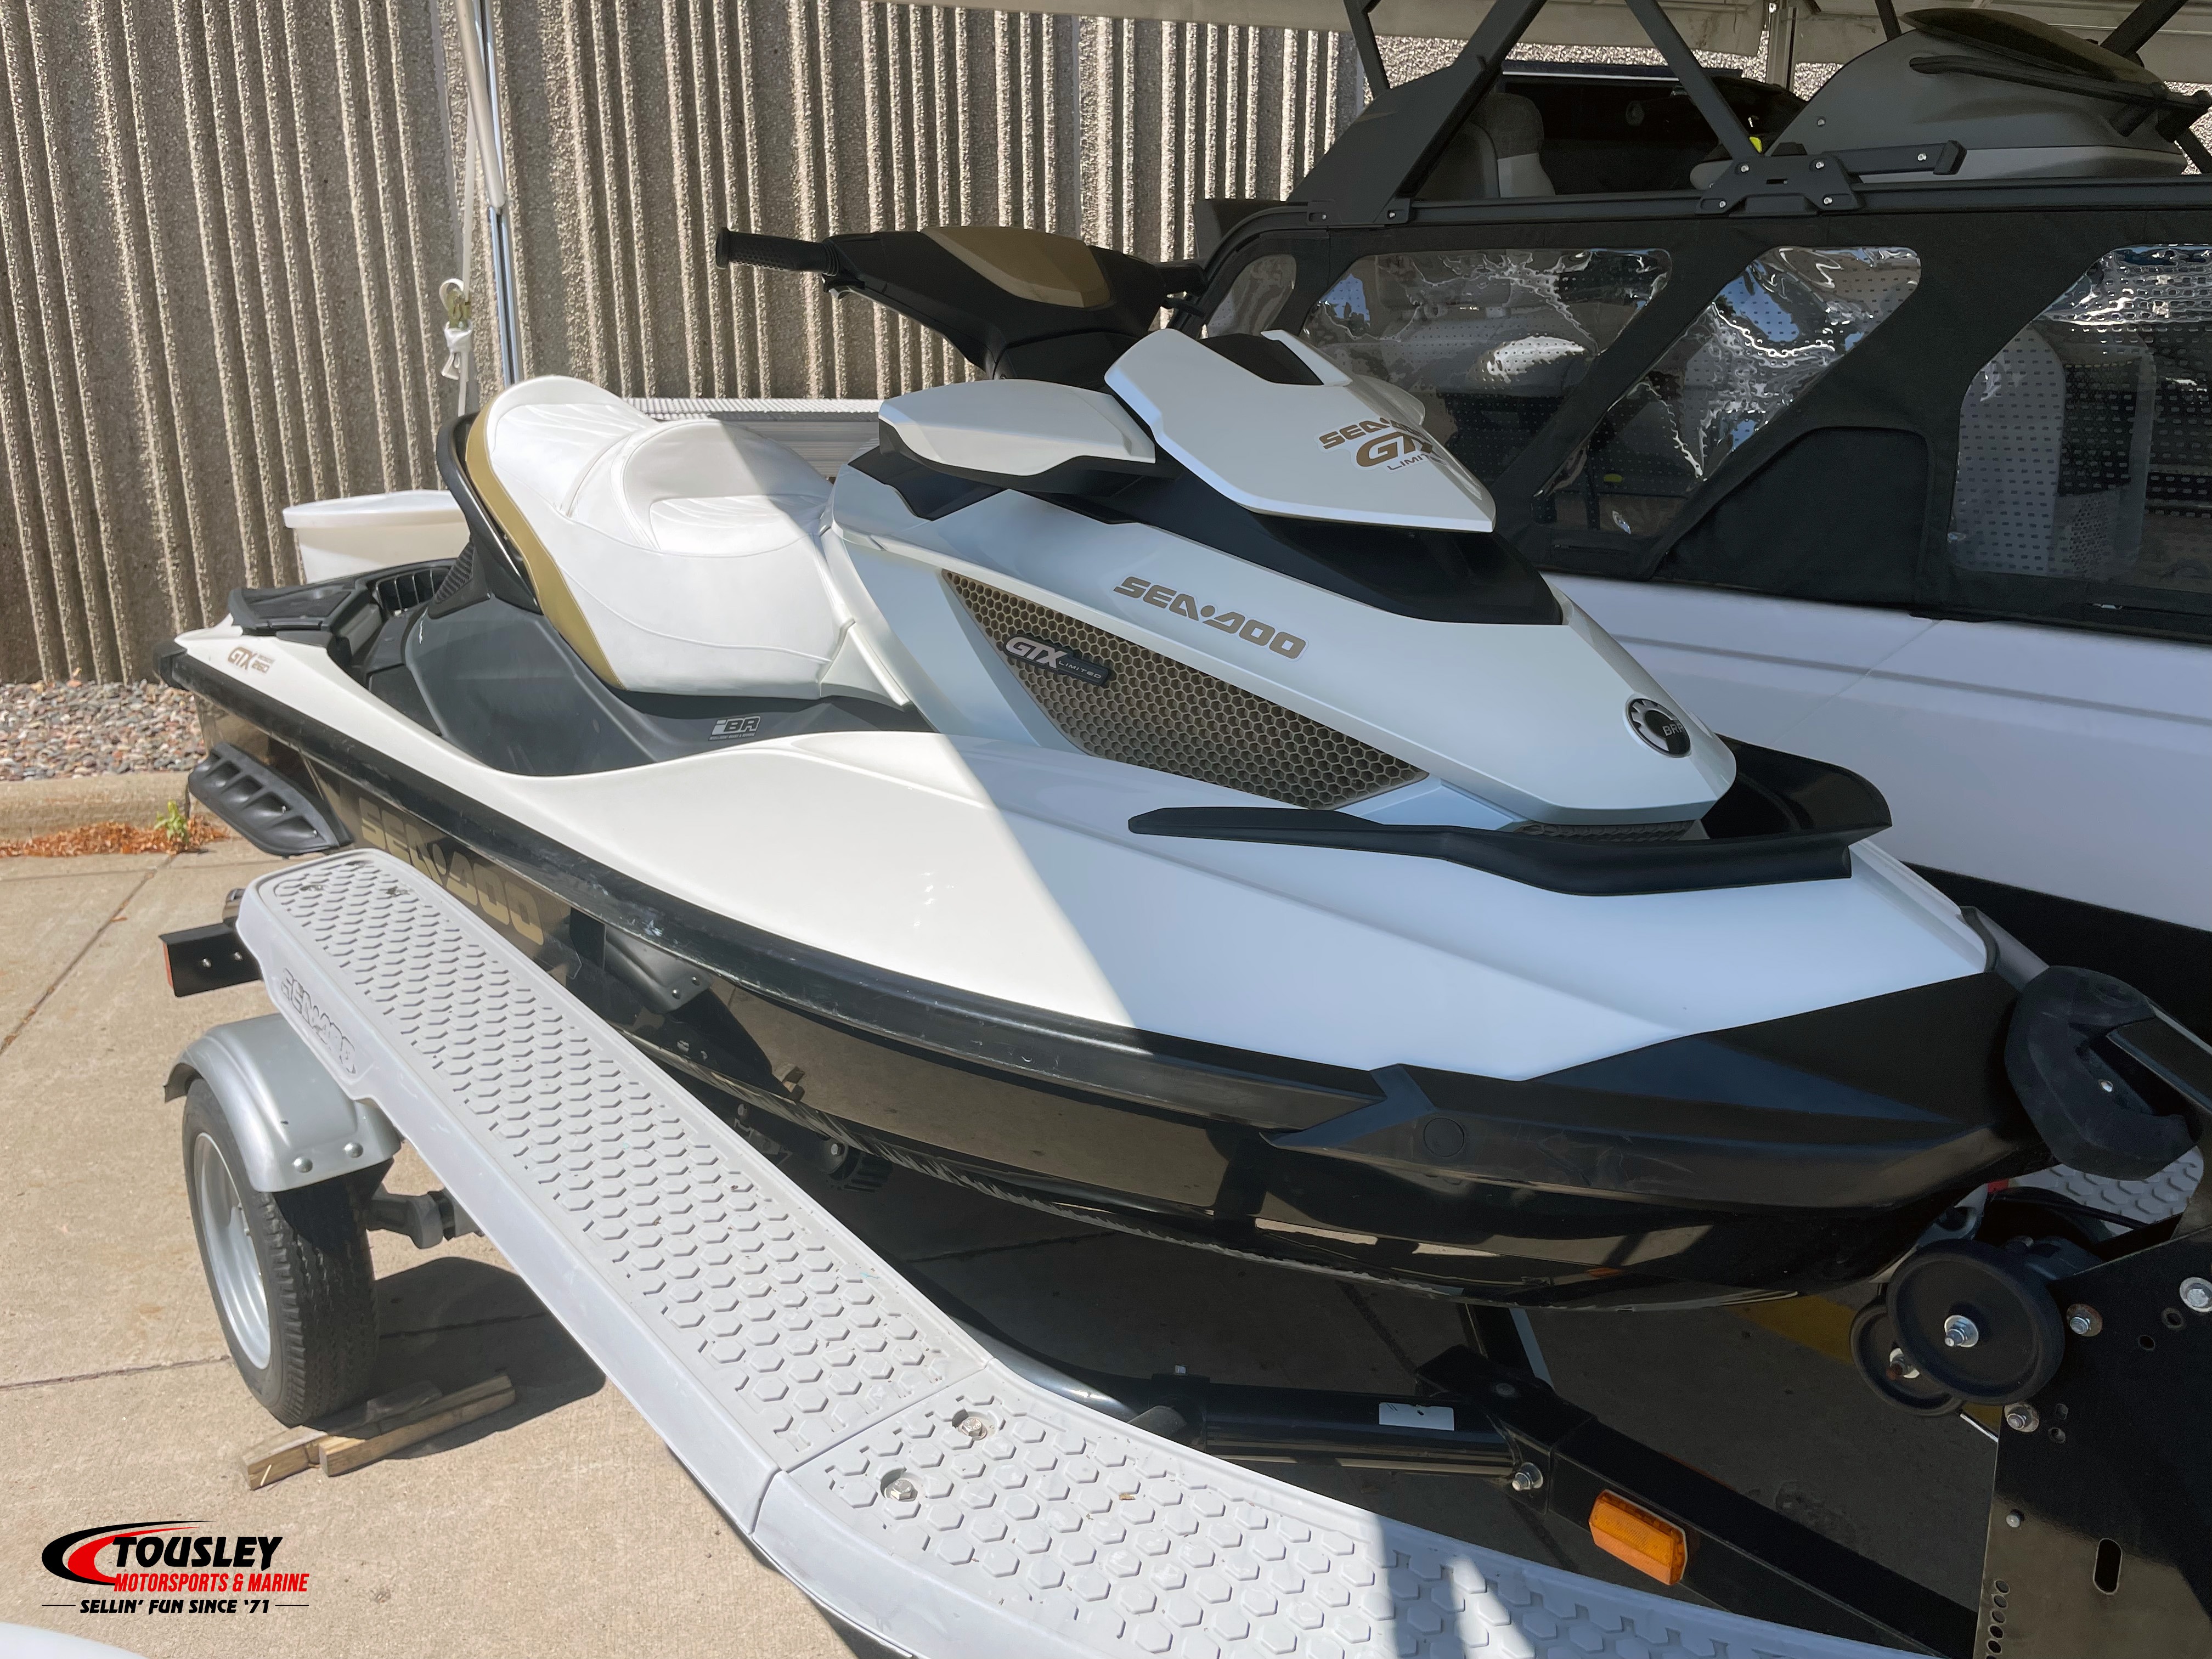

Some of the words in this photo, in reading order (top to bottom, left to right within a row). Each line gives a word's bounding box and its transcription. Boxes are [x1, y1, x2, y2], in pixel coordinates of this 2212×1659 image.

[1387, 454, 1447, 470] LIMIT
[228, 647, 258, 670] GTX
[1006, 637, 1068, 669] GTX
[1058, 660, 1102, 679] LIMITED
[1662, 723, 1683, 736] BRP
